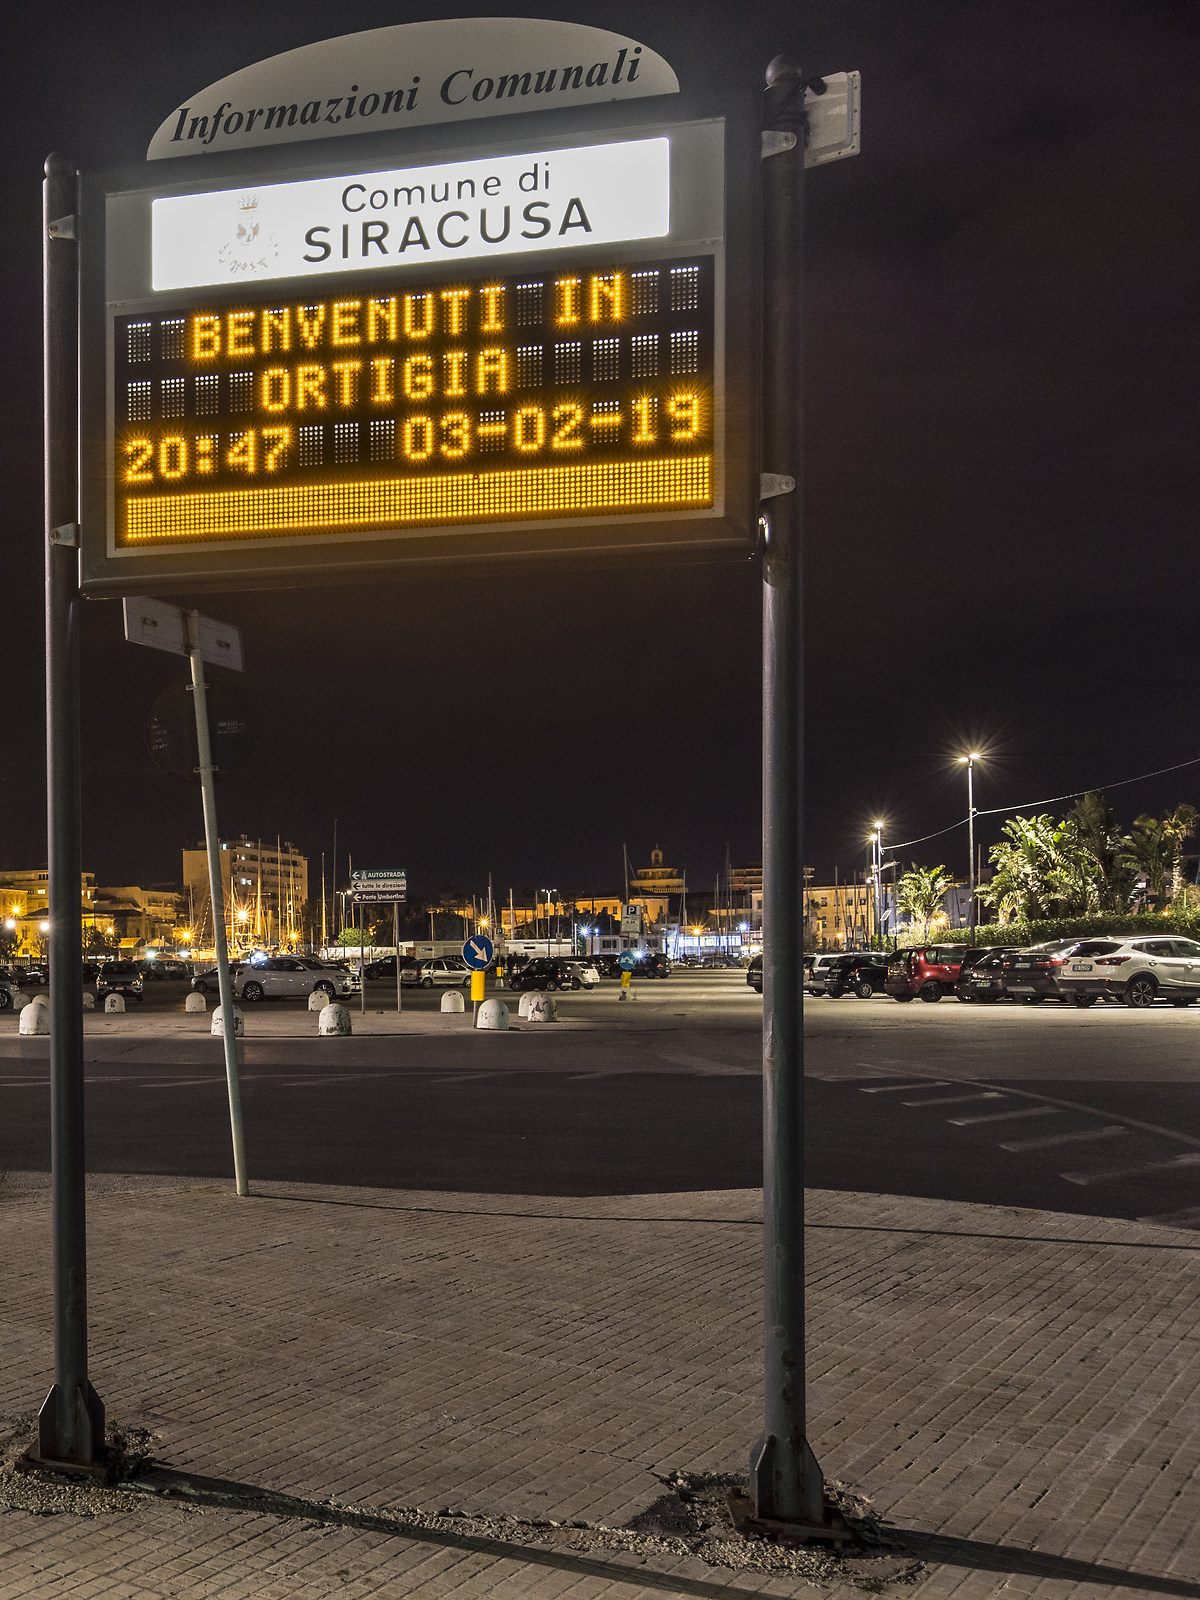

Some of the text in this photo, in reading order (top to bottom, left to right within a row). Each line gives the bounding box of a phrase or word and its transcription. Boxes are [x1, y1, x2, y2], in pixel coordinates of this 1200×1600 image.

[170, 46, 643, 145] Informazioni Comunali
[341, 161, 550, 213] Comune di
[302, 197, 593, 263] SIRACUSA
[193, 274, 621, 358] BENVENUTI IN
[262, 349, 508, 411] ORTIGIA
[127, 394, 700, 481] 20:47 03-02-19
